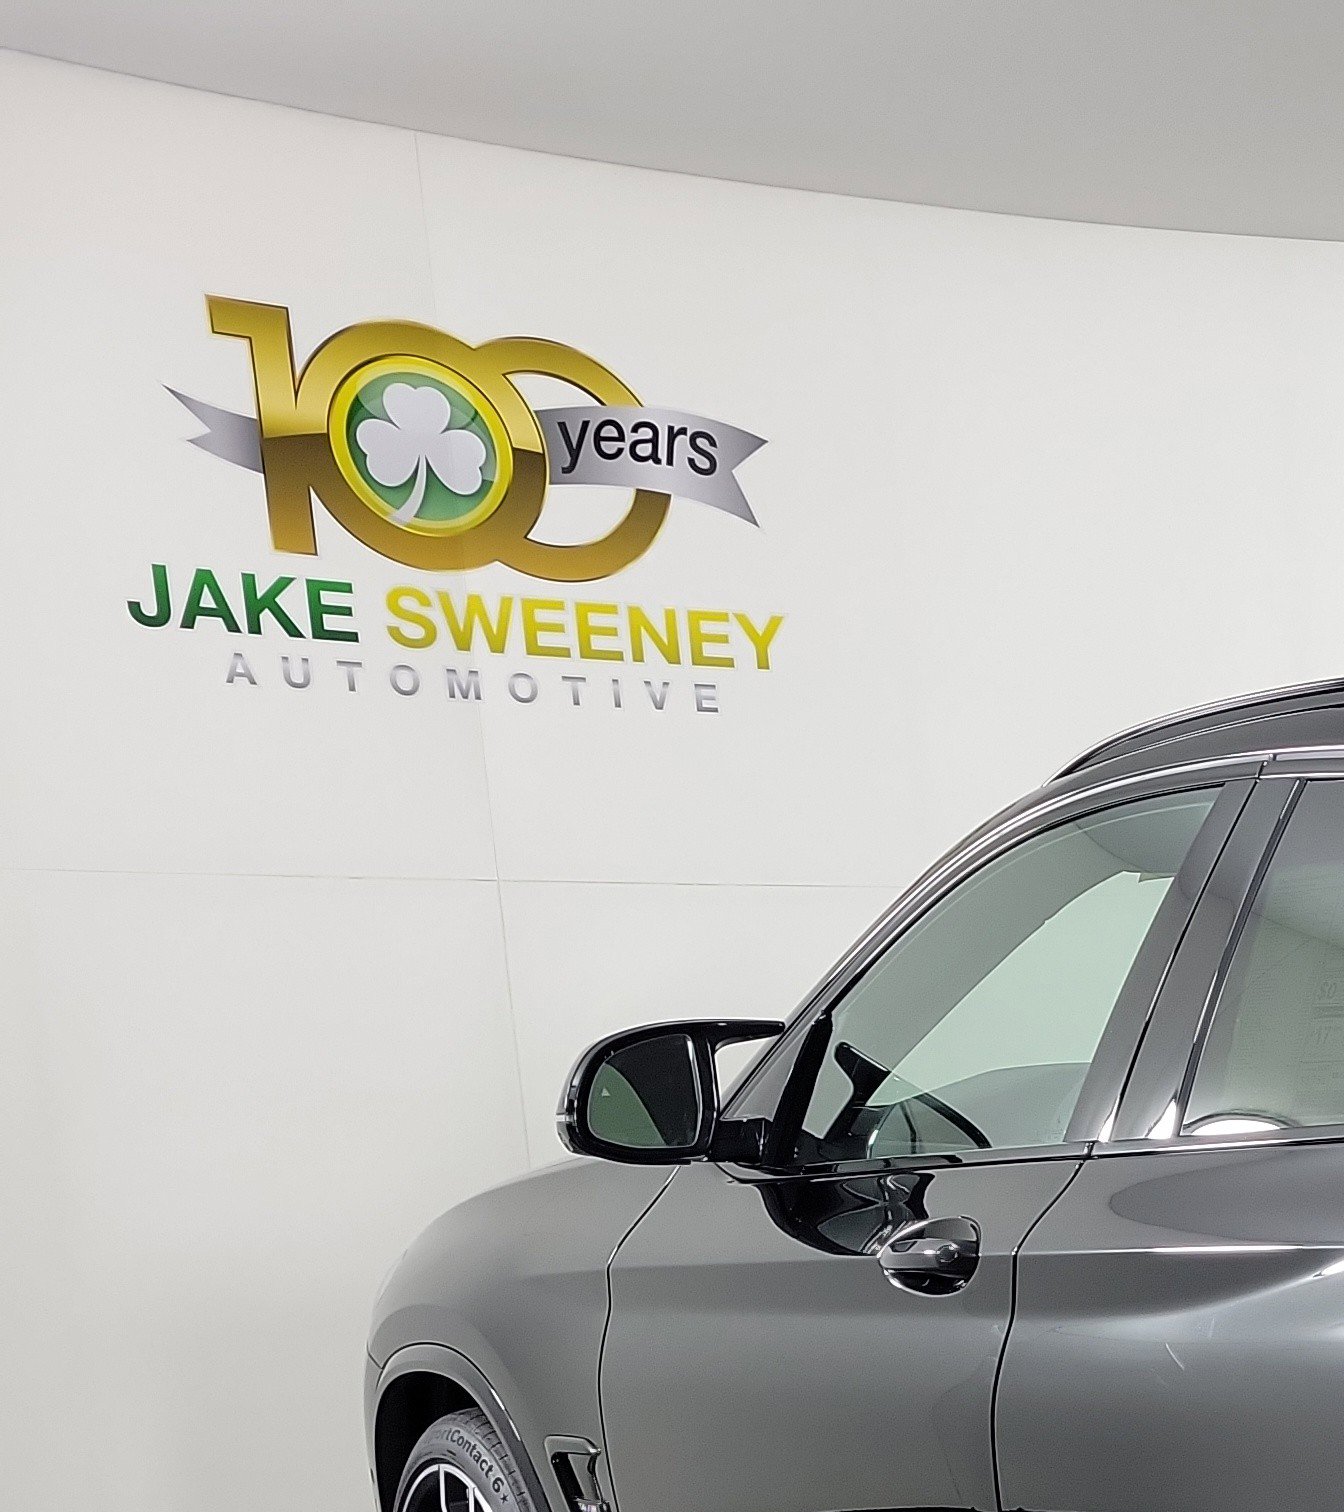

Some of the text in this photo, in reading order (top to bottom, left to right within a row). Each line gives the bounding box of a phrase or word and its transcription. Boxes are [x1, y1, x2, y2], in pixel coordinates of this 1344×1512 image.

[204, 293, 673, 582] 100
[556, 415, 719, 477] years
[127, 563, 785, 671] JAKE SWEENEY
[225, 652, 720, 714] AUTOMOTIVE
[492, 1476, 504, 1493] 6
